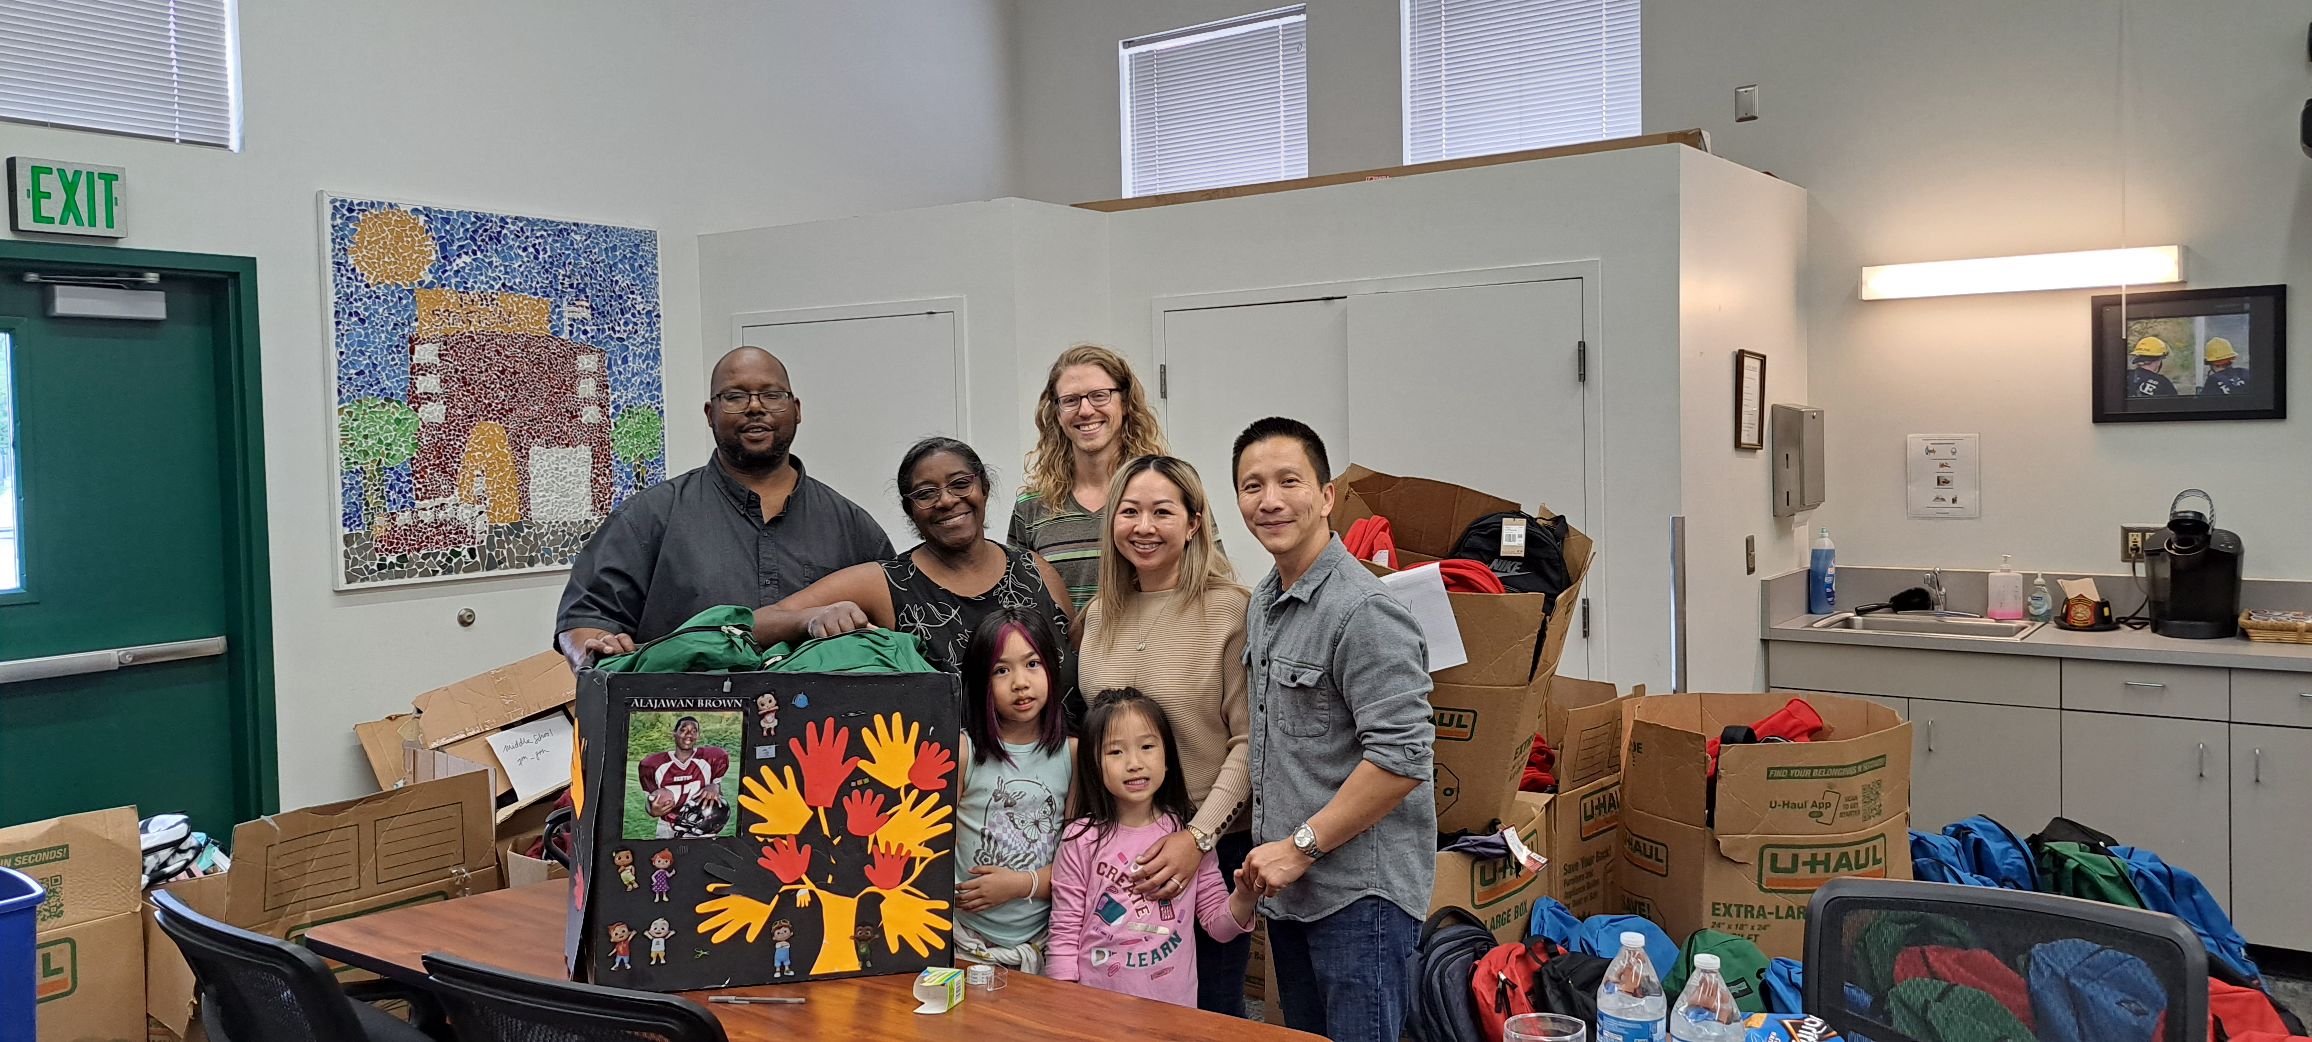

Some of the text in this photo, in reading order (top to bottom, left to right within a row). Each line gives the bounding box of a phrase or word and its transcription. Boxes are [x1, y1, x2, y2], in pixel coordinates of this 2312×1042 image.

[31, 166, 118, 229] EXIT
[1489, 559, 1523, 573] NIKE
[631, 698, 743, 709] ALAJAWAN BROWN
[503, 737, 533, 753] Middle
[1769, 768, 1788, 778] FIND
[1789, 768, 1812, 778] YOUR
[1769, 800, 1832, 810] U-Haul App
[14, 847, 67, 866] SECONDS!
[1769, 845, 1883, 874] U-HAUL
[1096, 861, 1150, 918] CREATE
[1514, 901, 1528, 920] BOX
[1126, 930, 1182, 967] LEARN
